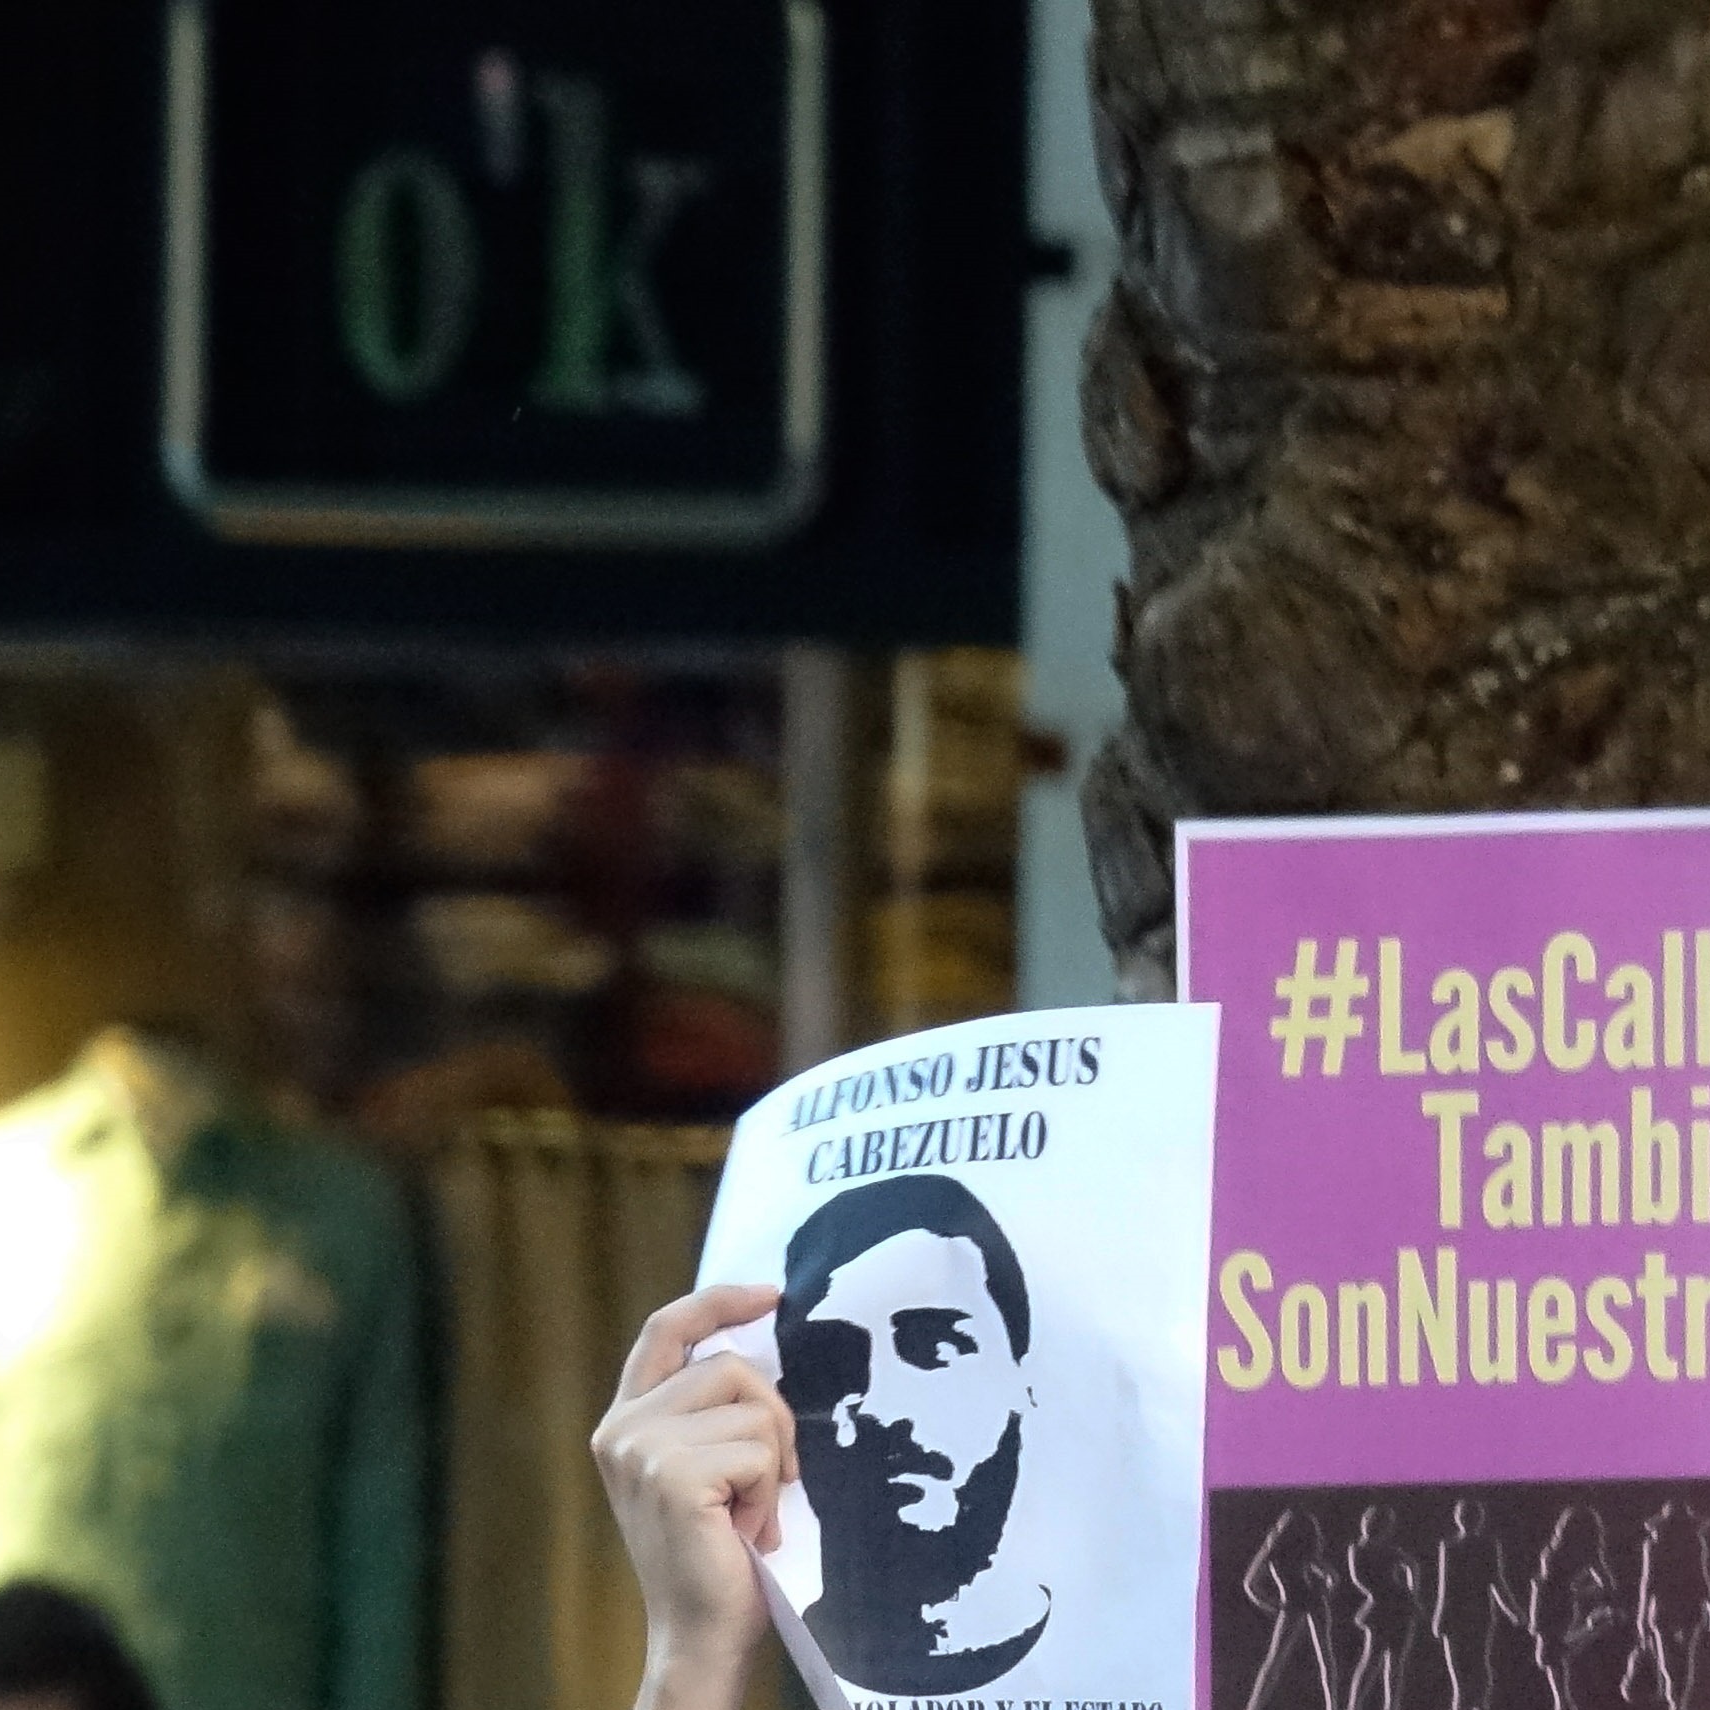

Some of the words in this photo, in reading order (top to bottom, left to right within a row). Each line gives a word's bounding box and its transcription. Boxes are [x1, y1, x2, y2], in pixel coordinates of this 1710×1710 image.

[780, 1052, 954, 1135] ALFONSO
[966, 1037, 1101, 1093] JESUS
[807, 1110, 1048, 1184] CABEZUELO
